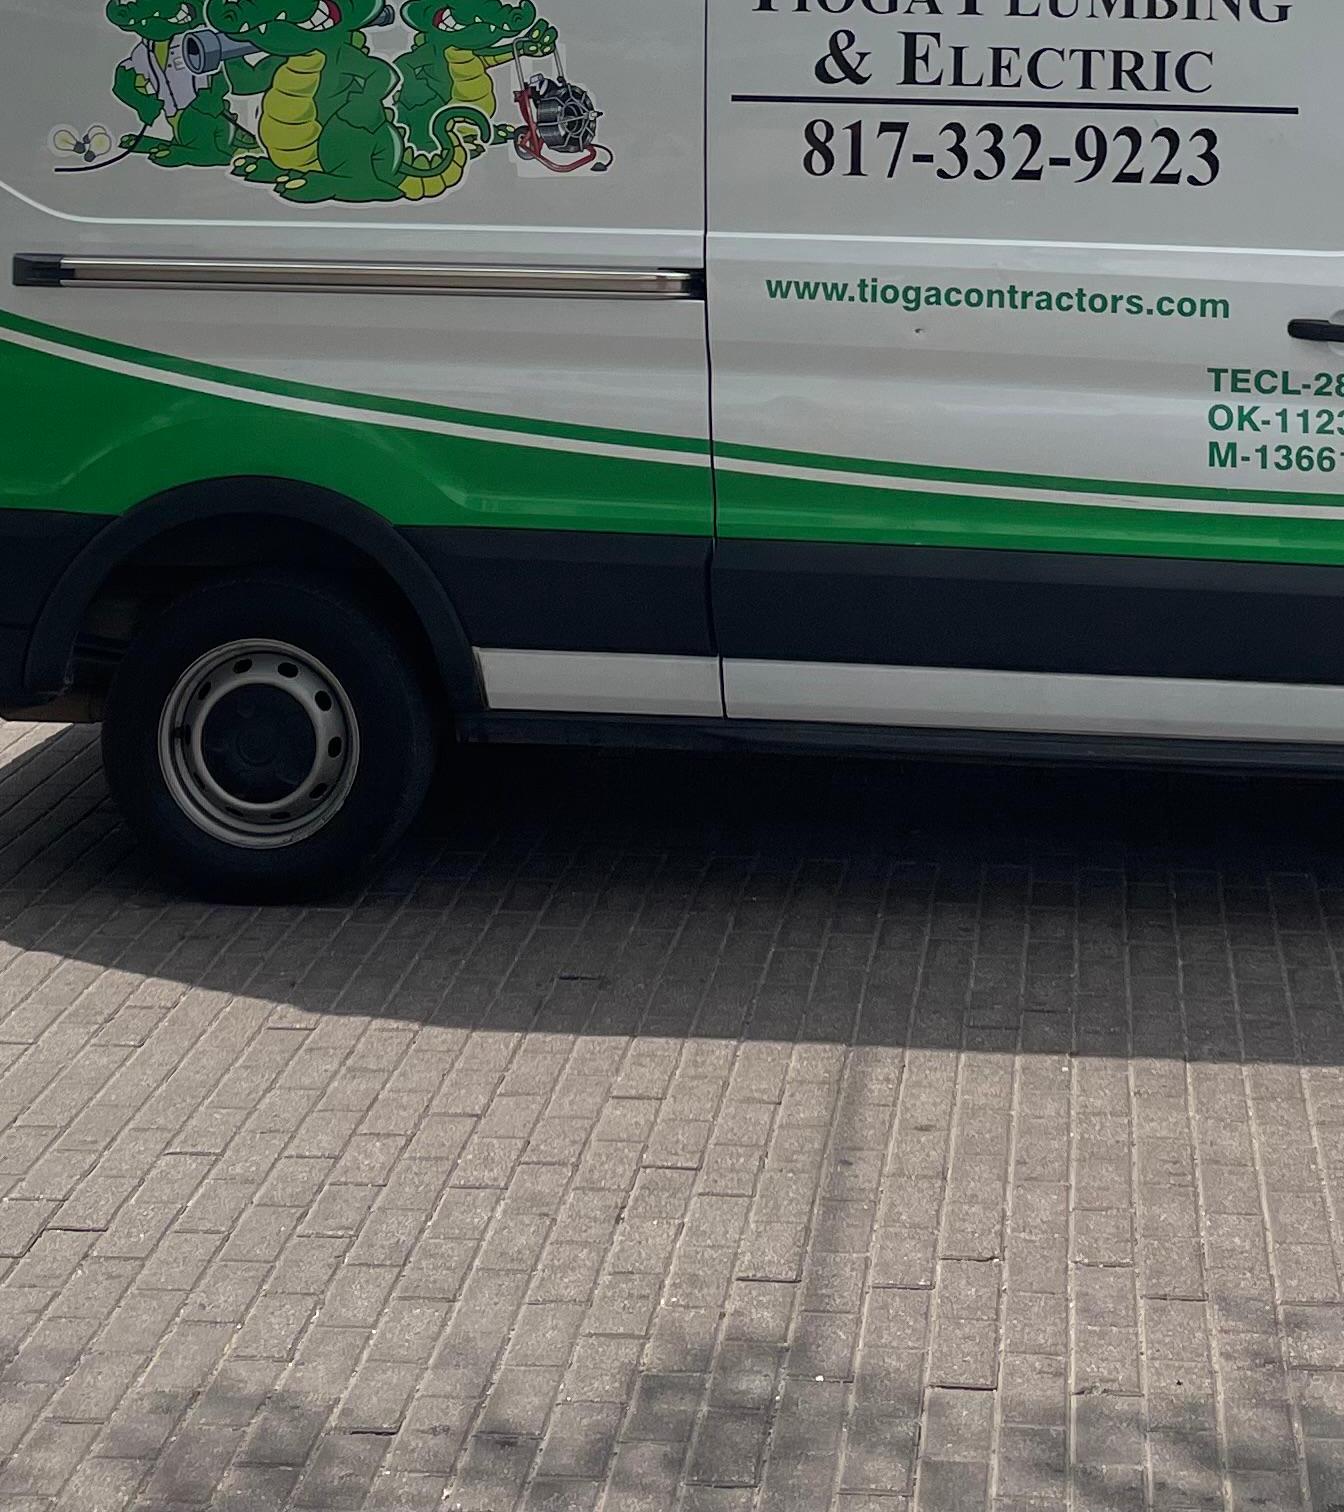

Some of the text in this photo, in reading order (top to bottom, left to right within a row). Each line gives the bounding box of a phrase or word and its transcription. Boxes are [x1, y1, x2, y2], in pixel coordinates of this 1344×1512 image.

[815, 29, 1213, 93] & ELECTRIC
[803, 119, 1220, 186] 817-332-9223
[766, 278, 1230, 318] www.tiogacontractors.com
